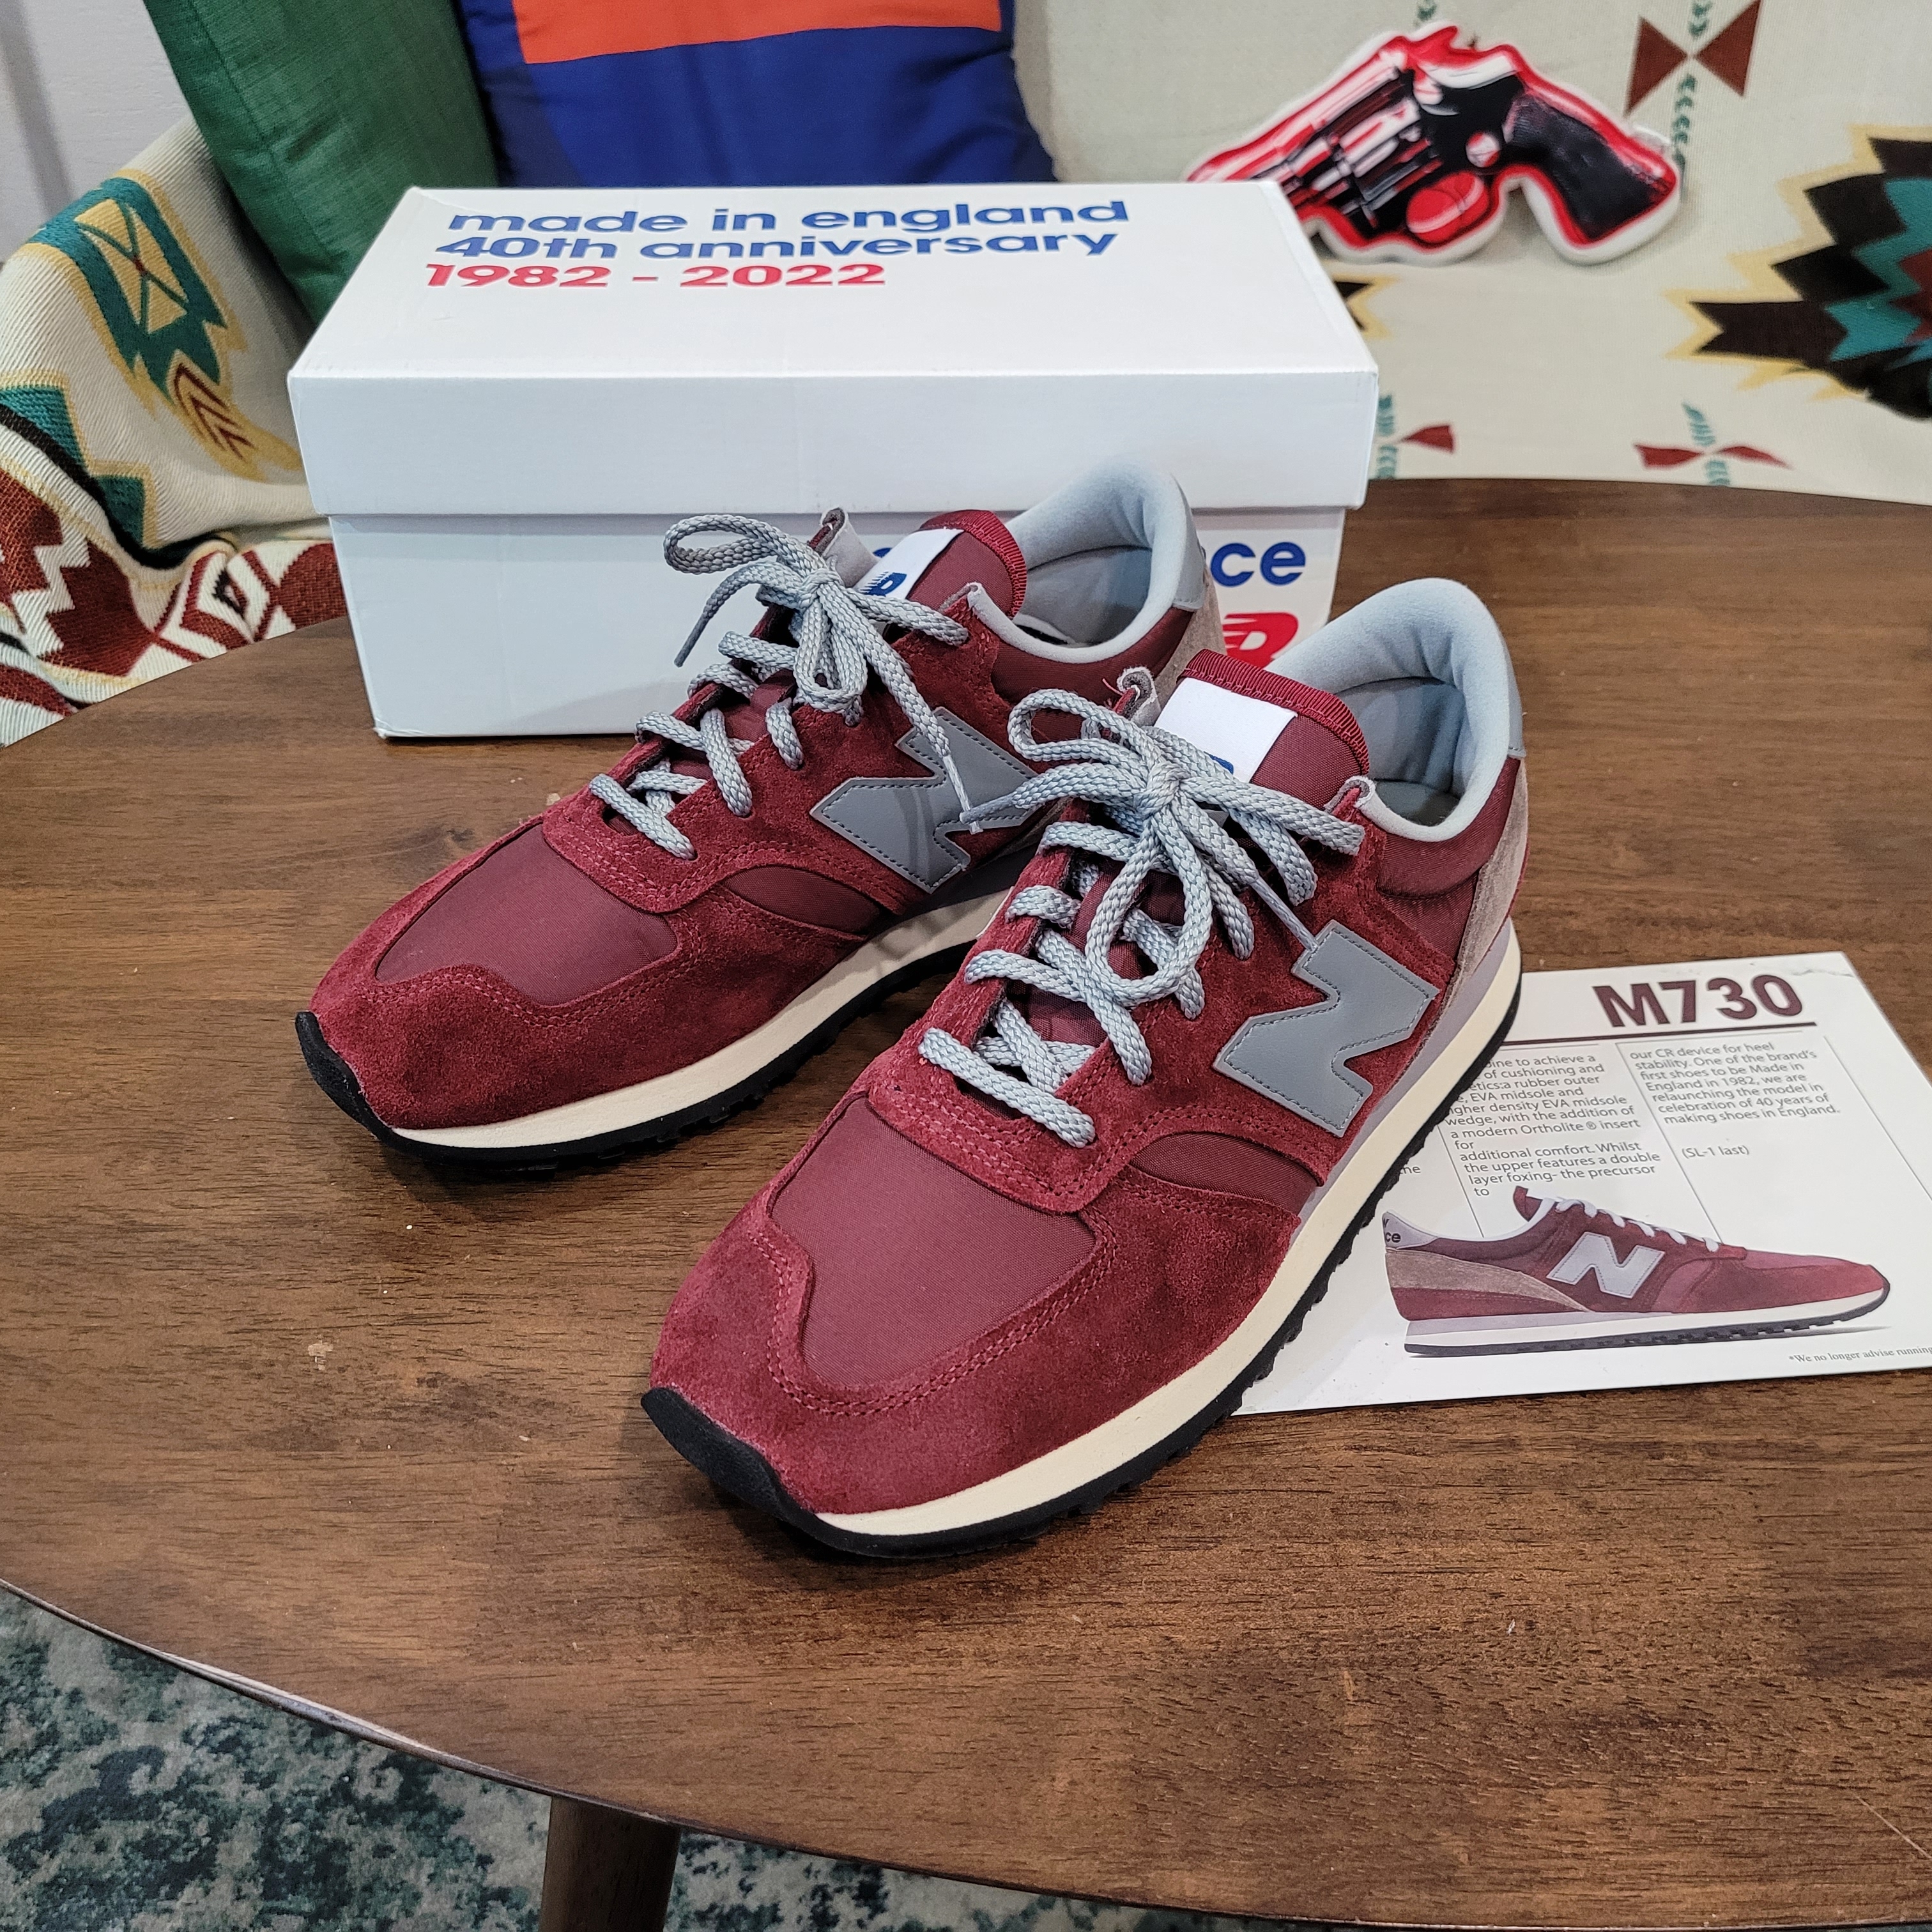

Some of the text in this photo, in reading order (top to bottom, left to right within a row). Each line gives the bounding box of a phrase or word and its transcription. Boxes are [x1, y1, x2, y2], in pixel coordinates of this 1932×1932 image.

[448, 201, 1128, 233] made in england
[435, 236, 1118, 258] 40th anniversary
[426, 263, 611, 287] 1982
[680, 264, 885, 287] 2022
[1211, 542, 1306, 586] ce
[1592, 974, 1802, 1027] M730
[1655, 1048, 1675, 1057] CR
[1677, 1046, 1721, 1056] device
[1722, 1044, 1742, 1053] for
[1744, 1042, 1774, 1052] heel
[1533, 1055, 1584, 1065] achieve
[1636, 1050, 1817, 1070] stability. One of the brand's
[1484, 1070, 1497, 1079] of
[1501, 1067, 1576, 1078] cushioning
[1579, 1064, 1604, 1073] and
[1640, 1071, 1667, 1080] first
[1669, 1070, 1709, 1078] shoes
[1728, 1066, 1747, 1075] be
[1749, 1063, 1788, 1073] Made
[1470, 1076, 1599, 1091] etics:a rubber outer
[1645, 1079, 1703, 1092] England
[1784, 1074, 1807, 1082] are
[1652, 1083, 1823, 1101] relaunching the model in
[1470, 1092, 1498, 1102] EVA
[1501, 1089, 1554, 1100] midsole
[1558, 1087, 1584, 1096] and
[1658, 1092, 1829, 1112] celebration of 40 years of
[1450, 1096, 1627, 1116] igher density EVA midsole
[1664, 1104, 1839, 1123] making shoes in England.
[1445, 1106, 1634, 1126] wedge, with the addition of
[1462, 1127, 1518, 1138] modern
[1521, 1122, 1584, 1134] Ortholite
[1599, 1119, 1641, 1129] insert
[1454, 1140, 1474, 1149] for
[1460, 1142, 1641, 1161] additional comfort. Whilst
[1682, 1145, 1750, 1159] (SL-1 last)
[1464, 1163, 1489, 1172] the
[1492, 1162, 1533, 1172] upper
[1537, 1159, 1595, 1169] features
[1610, 1152, 1660, 1163] double
[1468, 1166, 1655, 1186] layer foxing- the precursor
[1474, 1188, 1489, 1196] to
[1828, 1352, 1860, 1361] longer
[1862, 1349, 1894, 1358] advise
